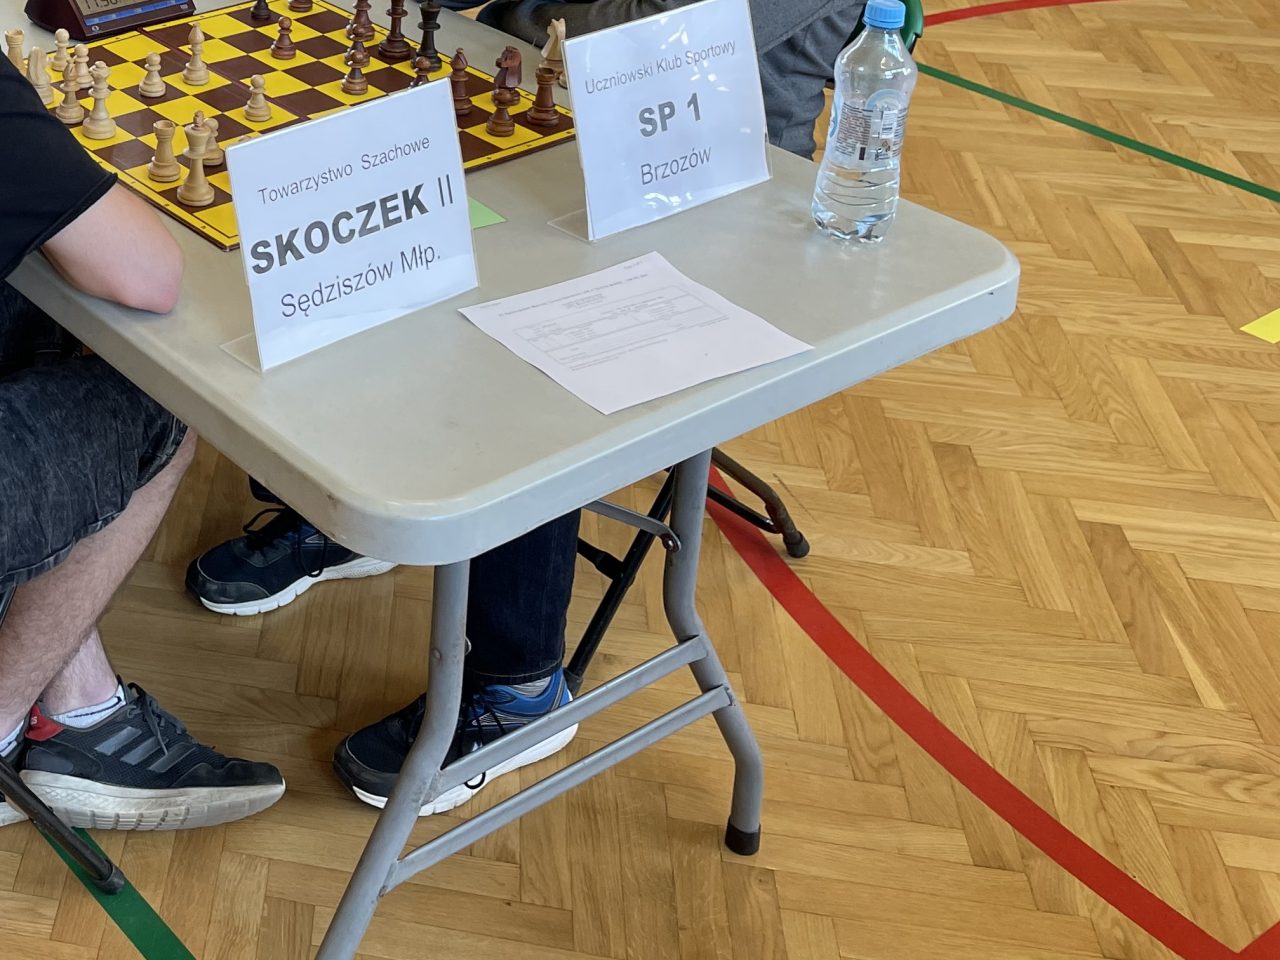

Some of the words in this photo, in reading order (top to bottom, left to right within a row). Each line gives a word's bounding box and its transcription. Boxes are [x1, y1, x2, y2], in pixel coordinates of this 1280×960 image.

[585, 64, 654, 94] Uczniowski
[656, 55, 682, 74] Klub
[685, 40, 736, 66] Sportowy
[638, 101, 676, 138] SP
[687, 92, 701, 122] 1
[258, 162, 353, 205] Towarzystwo
[361, 136, 430, 170] Szachowe
[640, 147, 712, 185] Brzozów
[250, 183, 430, 275] SKOCZEK
[437, 174, 454, 207] II
[280, 260, 394, 318] Sędziszów
[400, 243, 441, 274] Młp.
